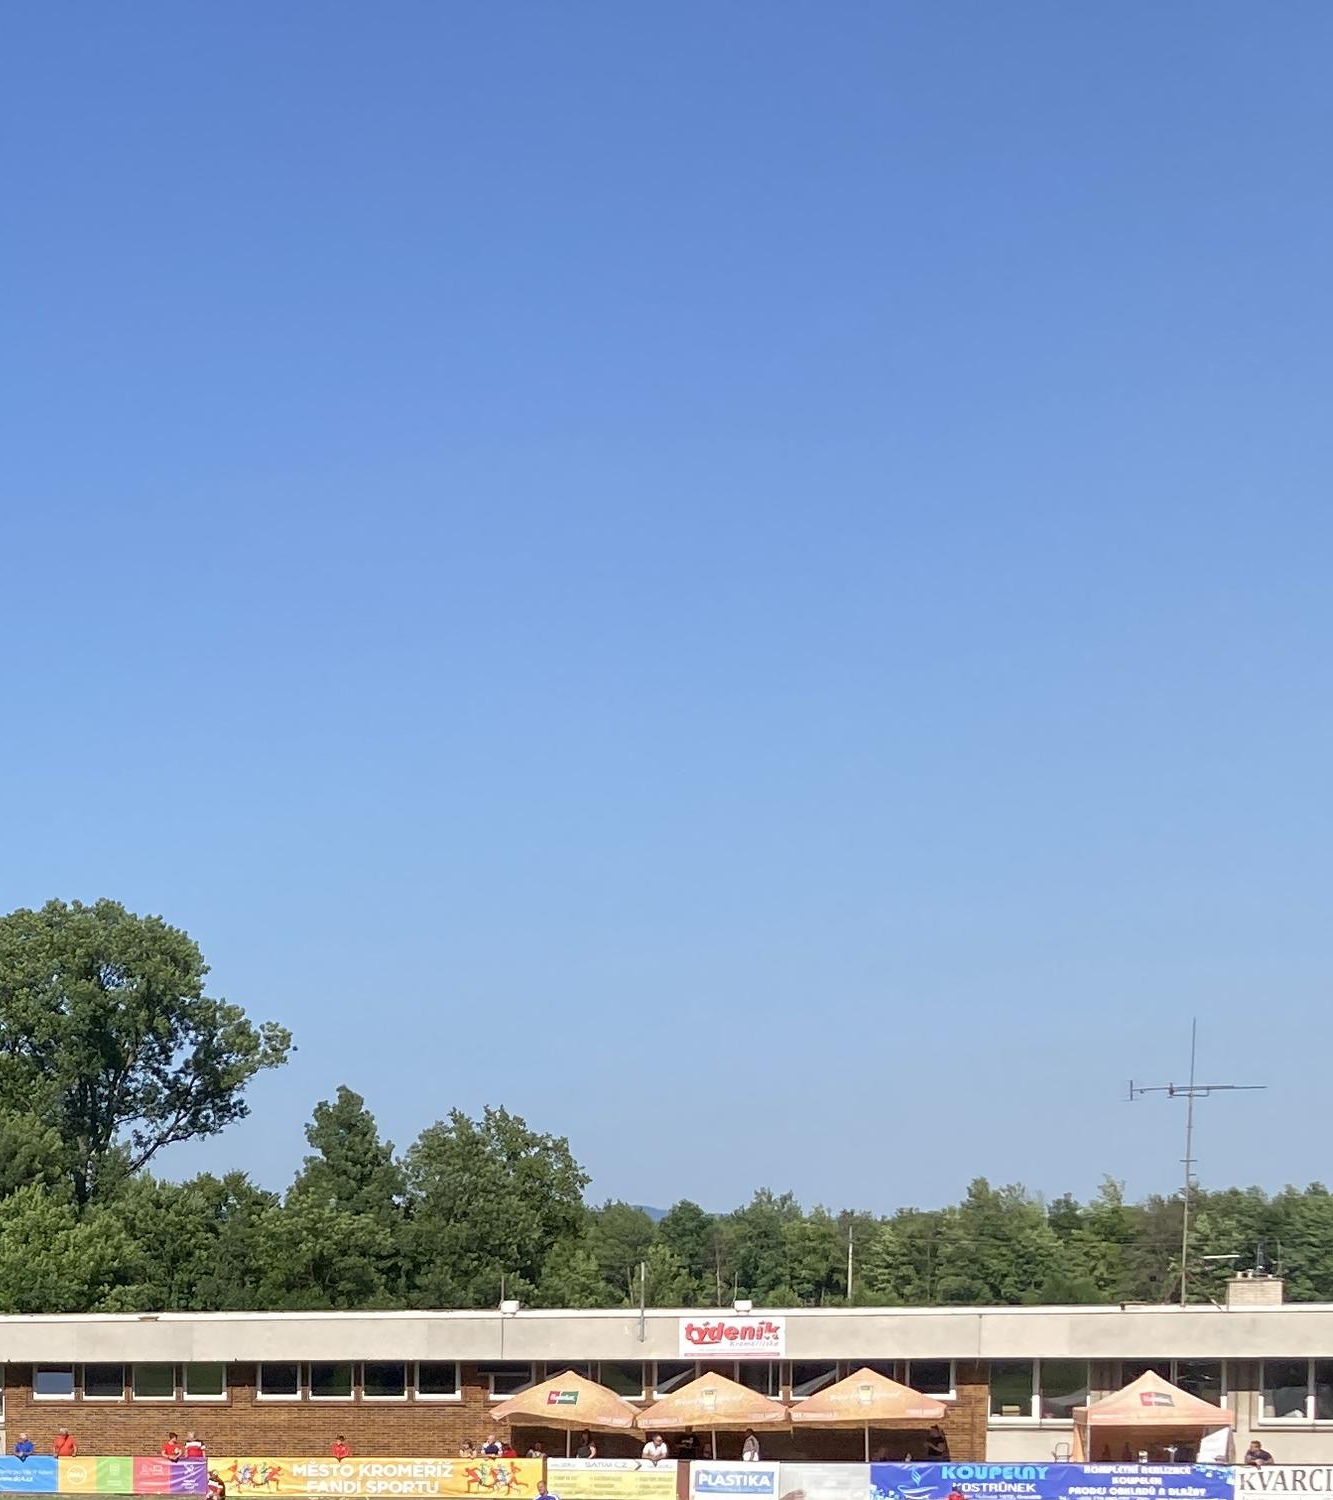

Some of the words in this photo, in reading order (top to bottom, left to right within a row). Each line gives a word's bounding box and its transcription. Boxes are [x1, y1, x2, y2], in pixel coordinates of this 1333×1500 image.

[292, 1460, 354, 1477] MĚSTO
[359, 1459, 454, 1478] KROMĚŘÍŽ
[941, 1465, 1049, 1480] KOUPELNY
[307, 1477, 362, 1494] FANDÍ
[365, 1480, 440, 1494] SPORTU
[698, 1472, 771, 1487] PLASTIKA
[1239, 1468, 1333, 1492] KVARCI
